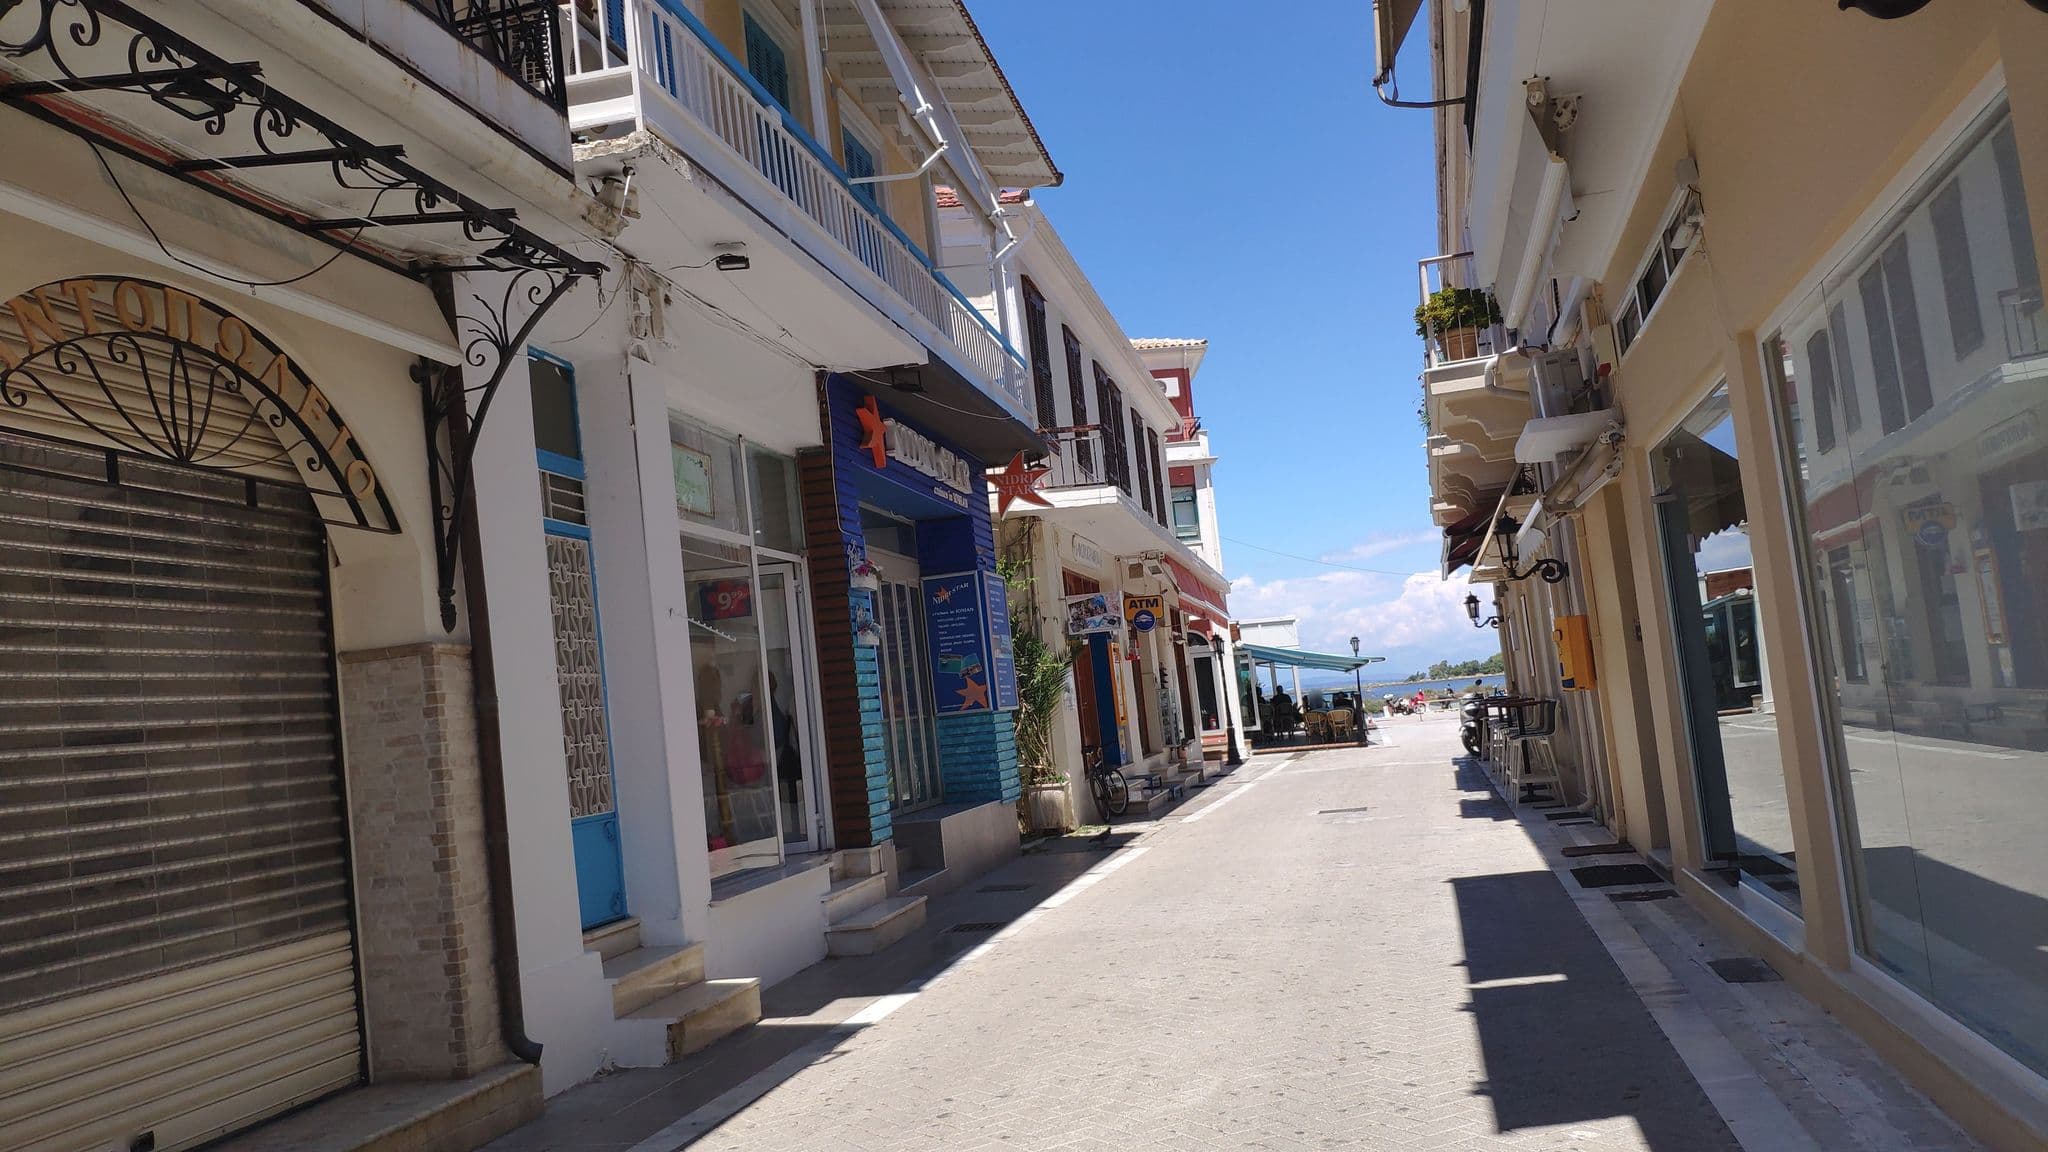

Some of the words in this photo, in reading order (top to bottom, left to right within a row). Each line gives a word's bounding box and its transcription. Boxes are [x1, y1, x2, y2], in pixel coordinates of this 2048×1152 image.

[0, 279, 376, 501] ΝΤΟΠΩΛΕΙΟ
[996, 473, 1033, 485] NIDRI
[999, 484, 1033, 496] STAR
[1128, 598, 1159, 610] ATM
